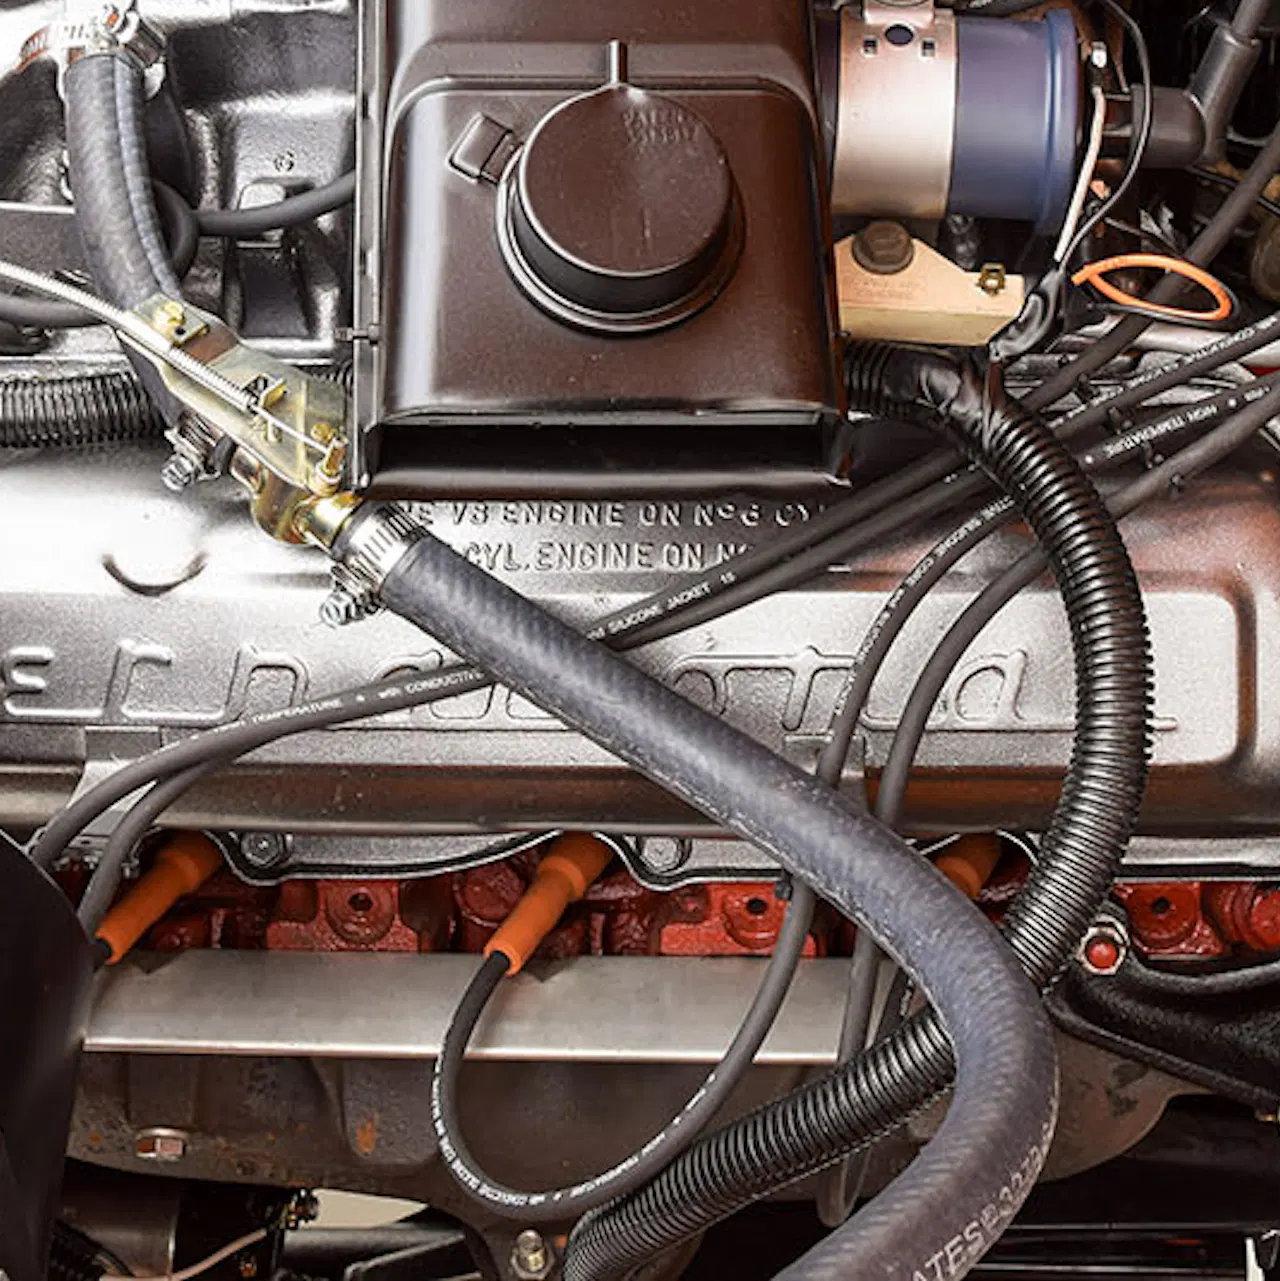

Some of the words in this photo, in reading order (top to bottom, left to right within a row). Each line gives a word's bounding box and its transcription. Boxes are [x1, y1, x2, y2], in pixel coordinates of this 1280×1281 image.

[503, 501, 624, 526] ENGINE
[639, 503, 681, 527] ON
[661, 542, 705, 570] ON
[667, 580, 713, 611] JACKET
